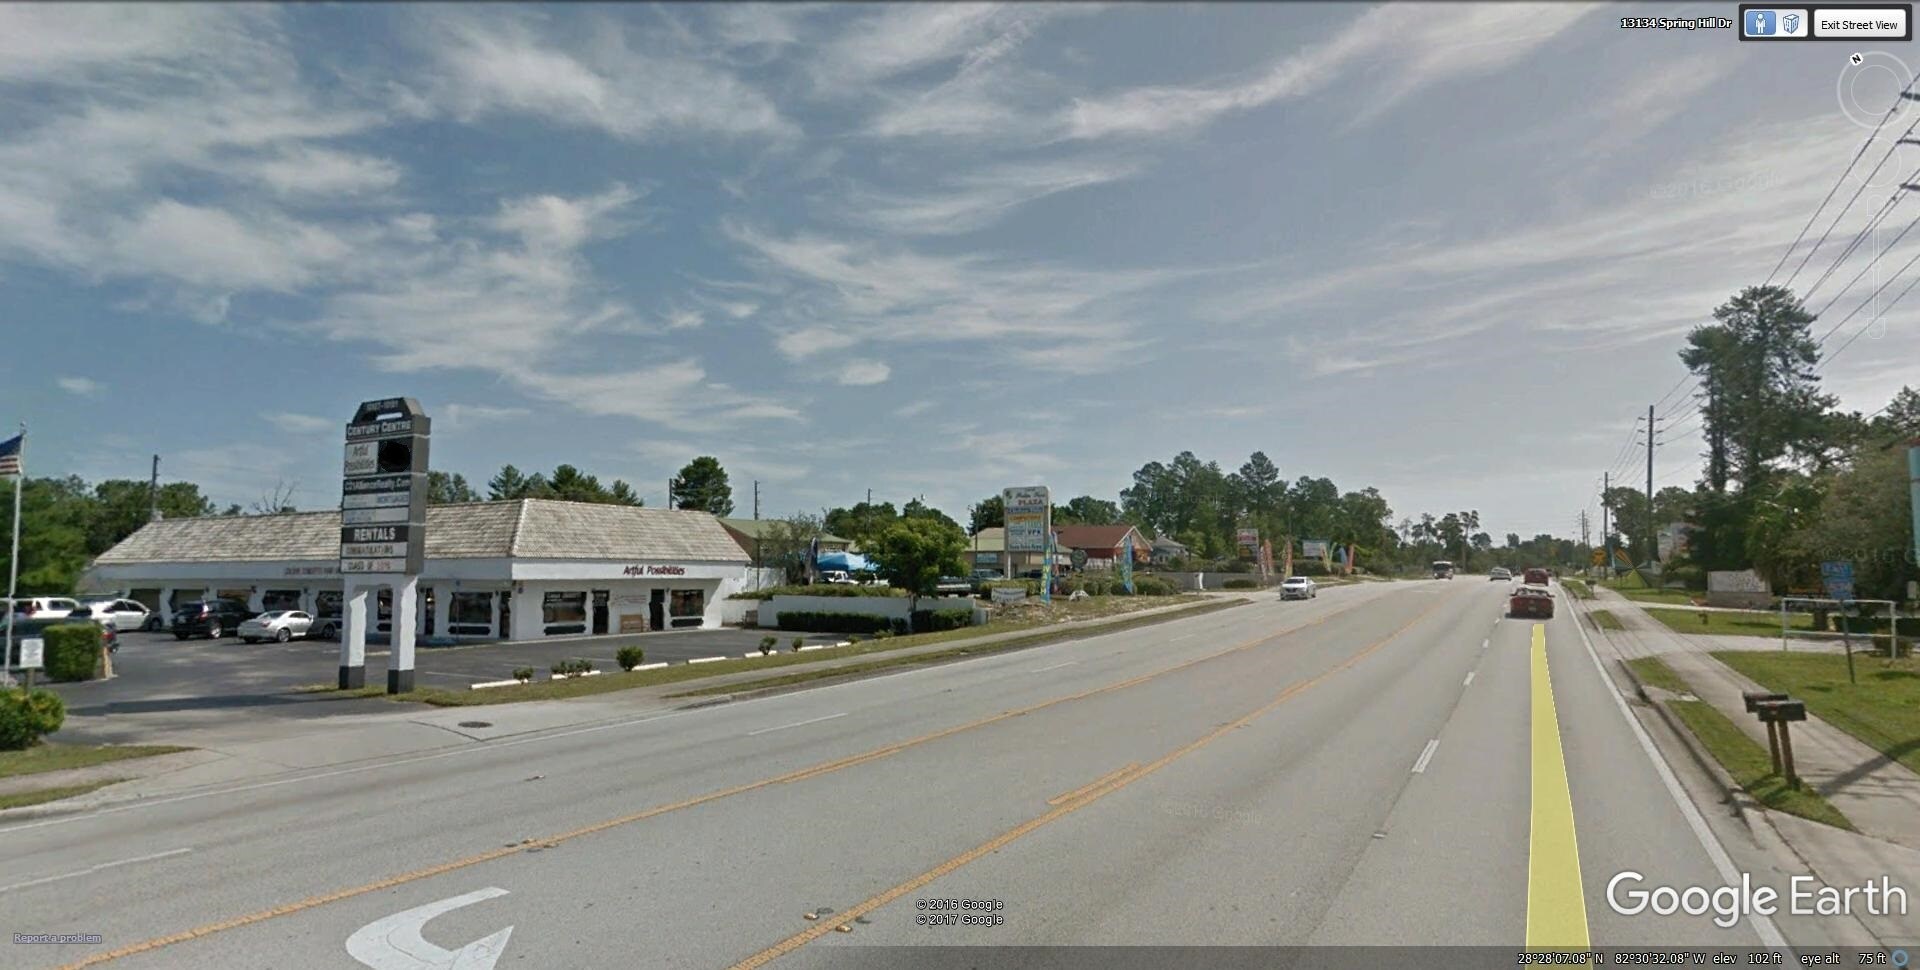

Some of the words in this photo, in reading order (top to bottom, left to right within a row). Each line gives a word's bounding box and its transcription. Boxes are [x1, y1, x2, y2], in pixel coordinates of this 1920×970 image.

[347, 424, 379, 436] CENTURY
[382, 421, 411, 432] CENTRE
[354, 527, 396, 541] RENTALS
[624, 565, 644, 577] Artful
[647, 566, 685, 576] Possibilities
